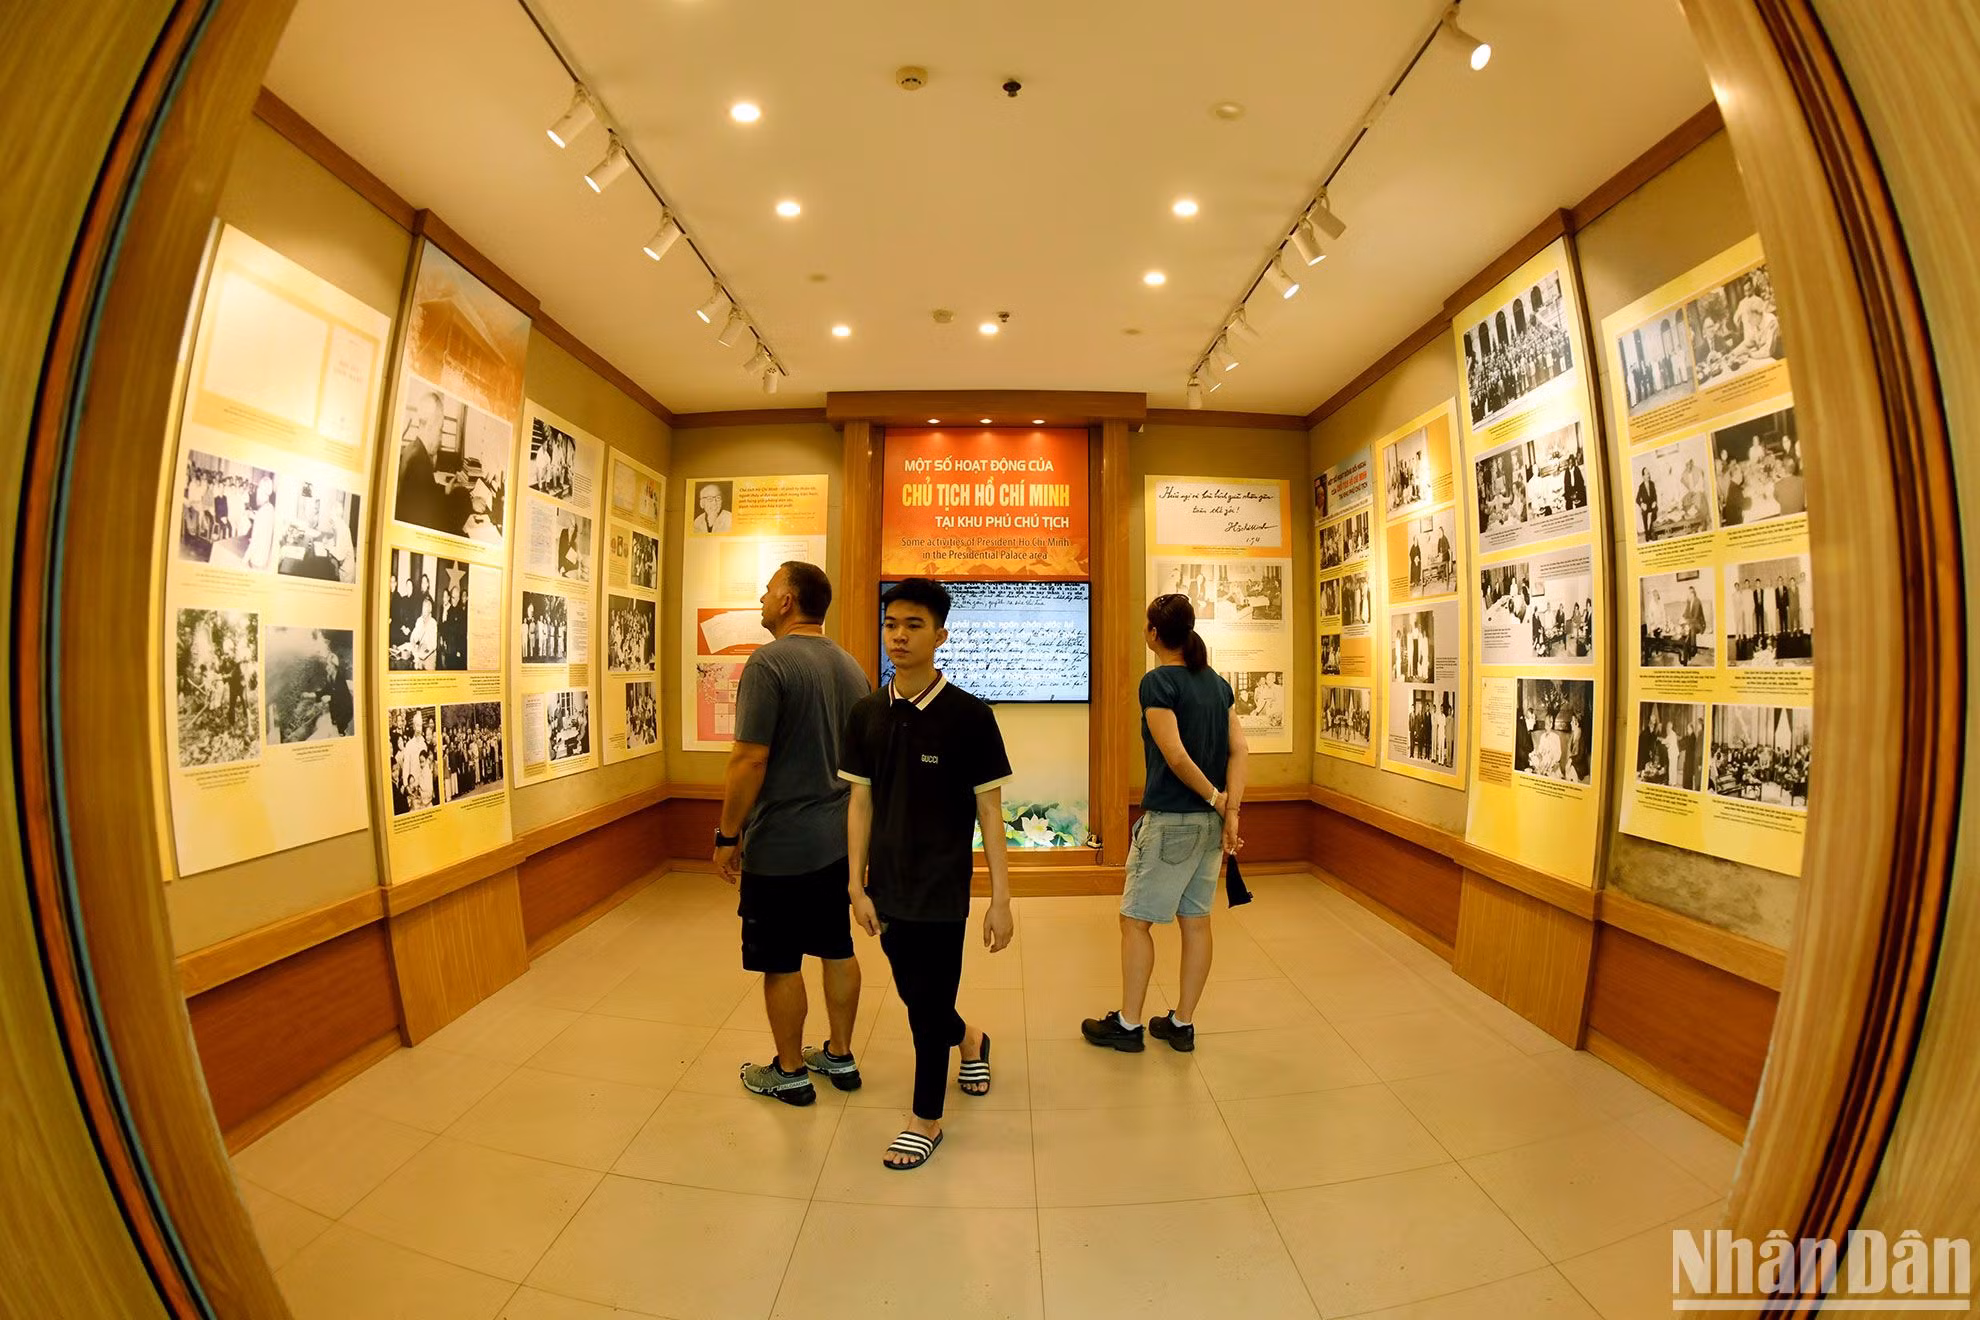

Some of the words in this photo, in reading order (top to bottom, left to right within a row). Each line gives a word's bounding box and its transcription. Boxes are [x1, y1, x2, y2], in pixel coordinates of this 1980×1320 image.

[904, 457, 932, 474] MỘT
[934, 455, 952, 472] SỐ
[955, 459, 988, 474] HOẠT
[990, 457, 1026, 474] ĐỘNG
[1028, 456, 1054, 472] CỦA
[902, 476, 932, 507] CHỦ
[936, 483, 970, 512] TỊCH
[975, 476, 995, 507] HỒ
[999, 480, 1025, 507] CHÍ
[1029, 483, 1070, 507] MINH
[935, 515, 955, 531] TẠI
[957, 515, 983, 528] KHU
[985, 513, 1011, 528] PHỦ
[1014, 513, 1040, 528] CHỦ
[1042, 515, 1069, 531] TỊCH
[901, 537, 926, 547] Some
[926, 538, 965, 547] activities
[966, 537, 976, 547] of
[977, 537, 1016, 547] President
[1018, 537, 1031, 547] Ho
[1032, 537, 1046, 547] Chi
[1047, 537, 1070, 547] Minh
[922, 551, 931, 560] in
[932, 550, 947, 560] the
[948, 549, 998, 560] Presidential
[1000, 550, 1028, 560] Palace
[1028, 551, 1048, 560] area
